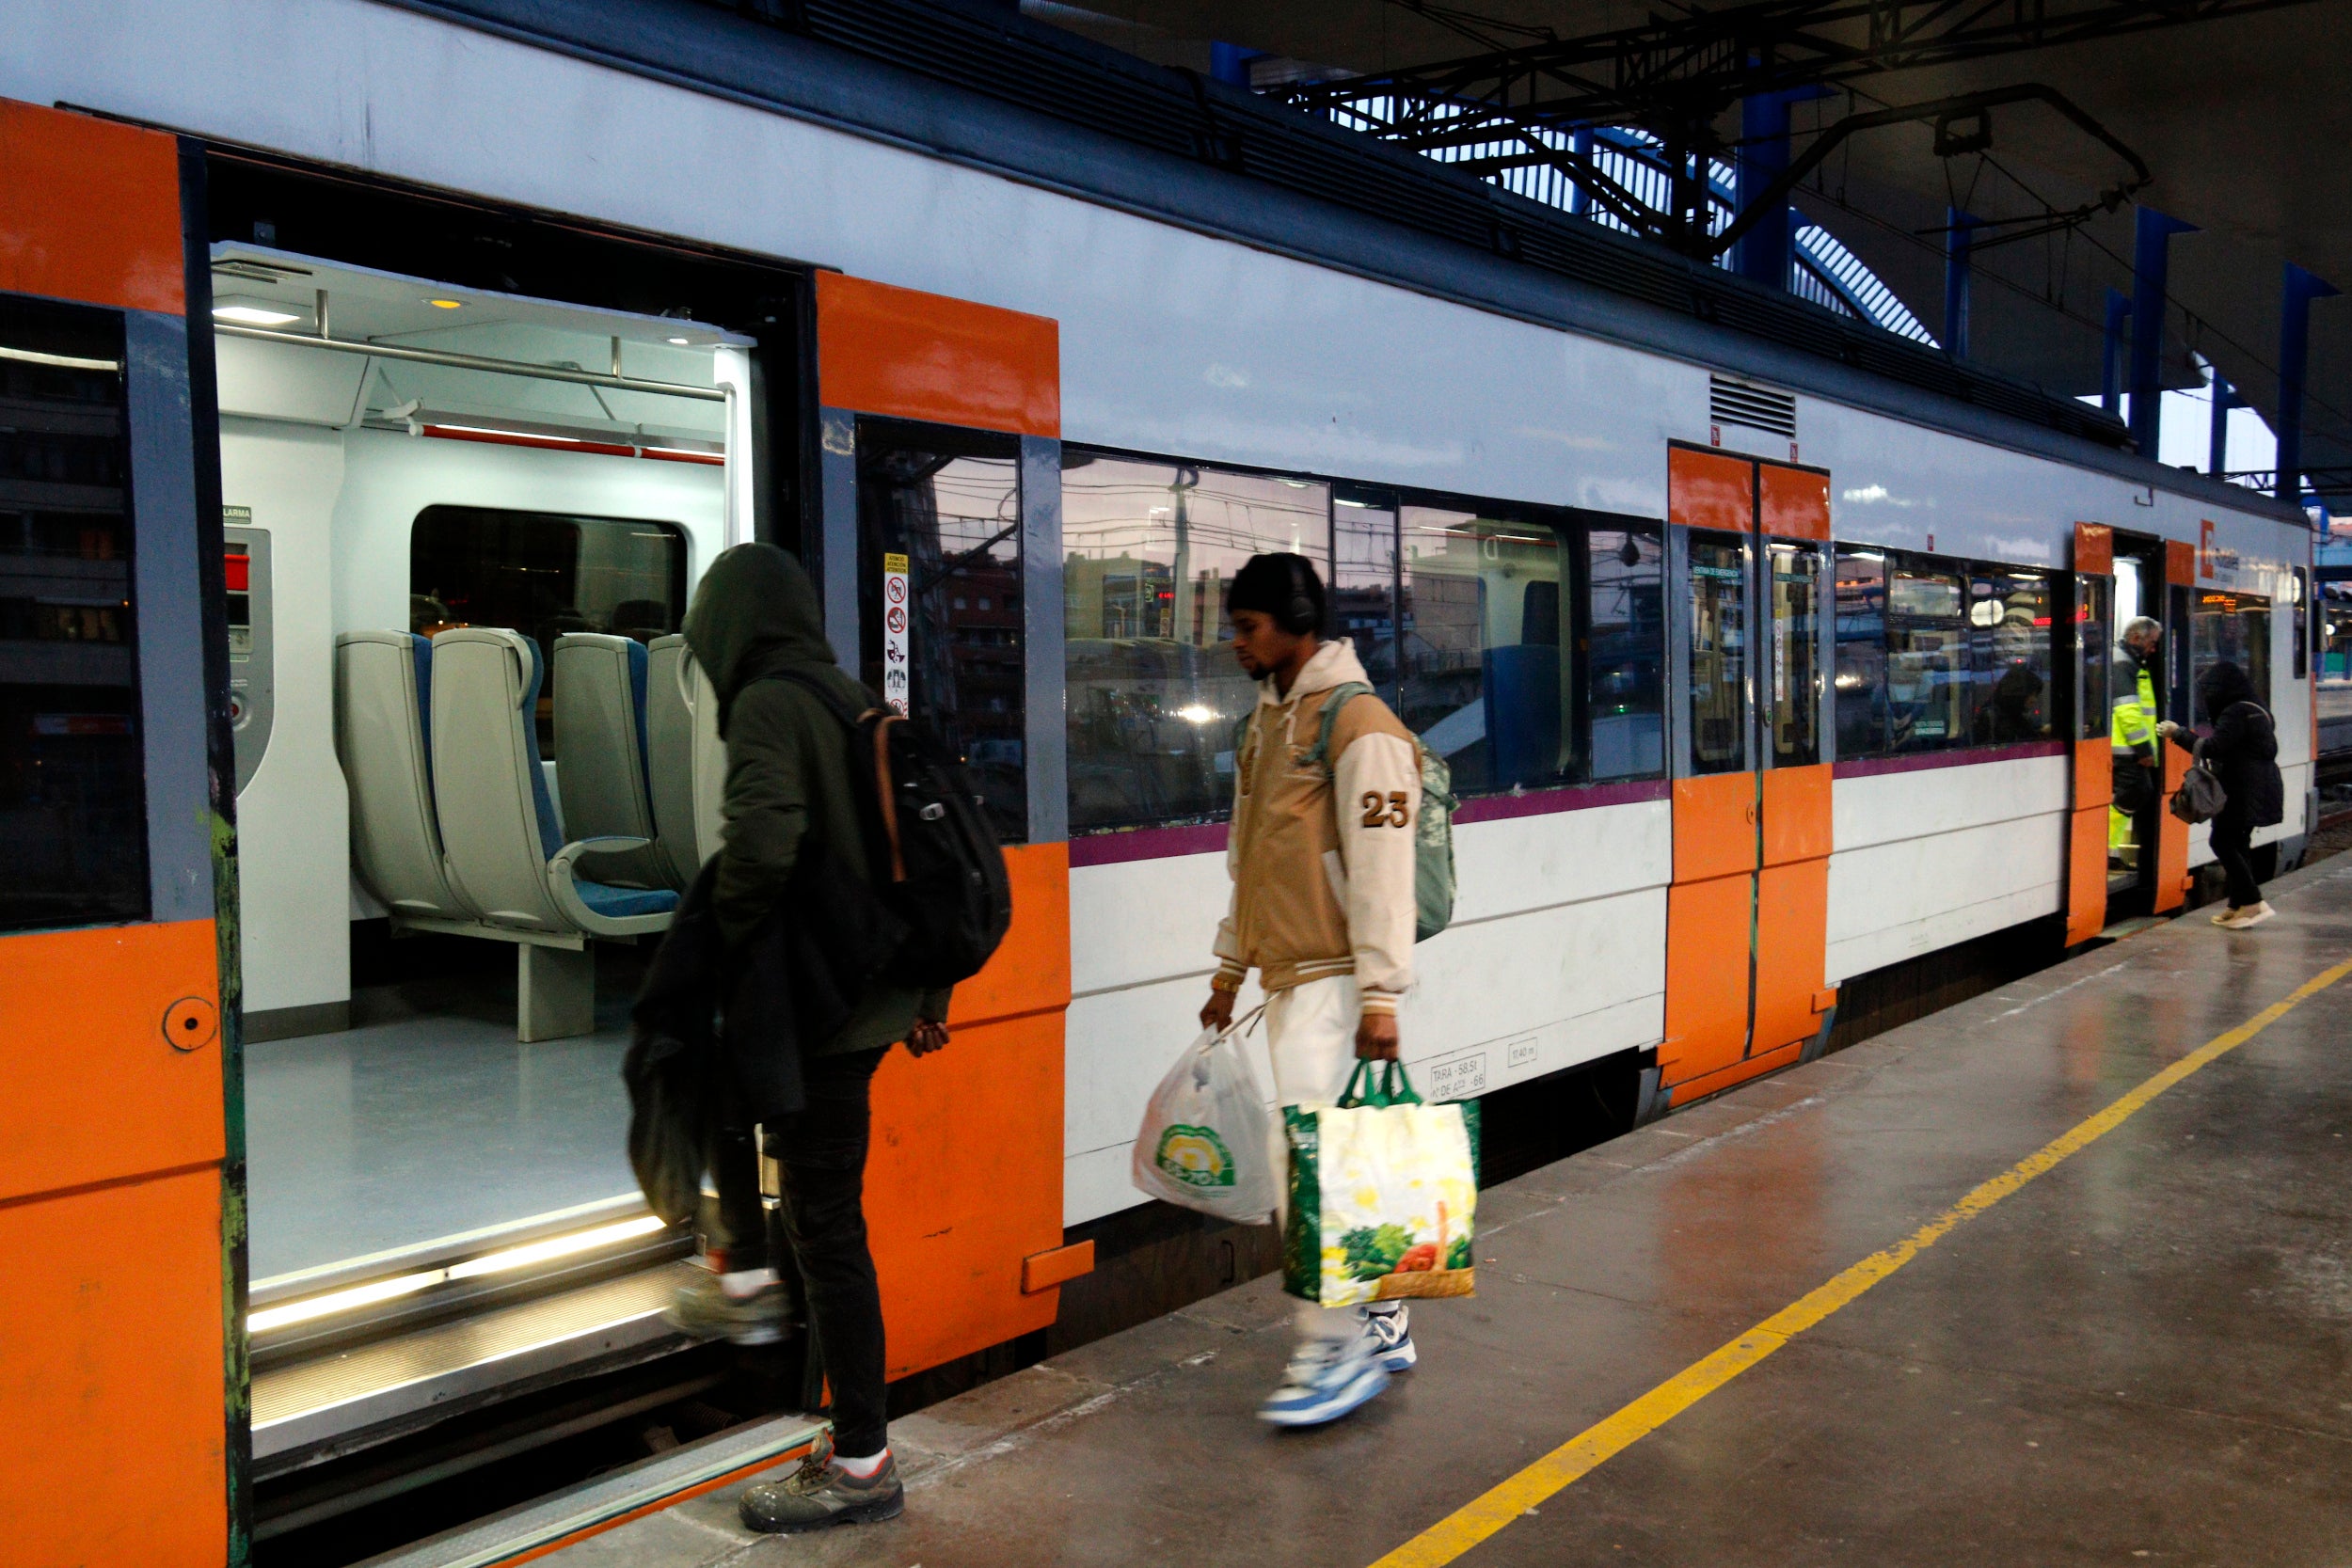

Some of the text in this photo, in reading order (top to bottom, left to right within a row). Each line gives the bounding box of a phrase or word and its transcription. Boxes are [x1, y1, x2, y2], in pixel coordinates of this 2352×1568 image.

[223, 508, 250, 517] LARMA
[1362, 790, 1409, 829] 23
[1433, 1068, 1453, 1082] TARA
[1440, 1084, 1450, 1097] DE
